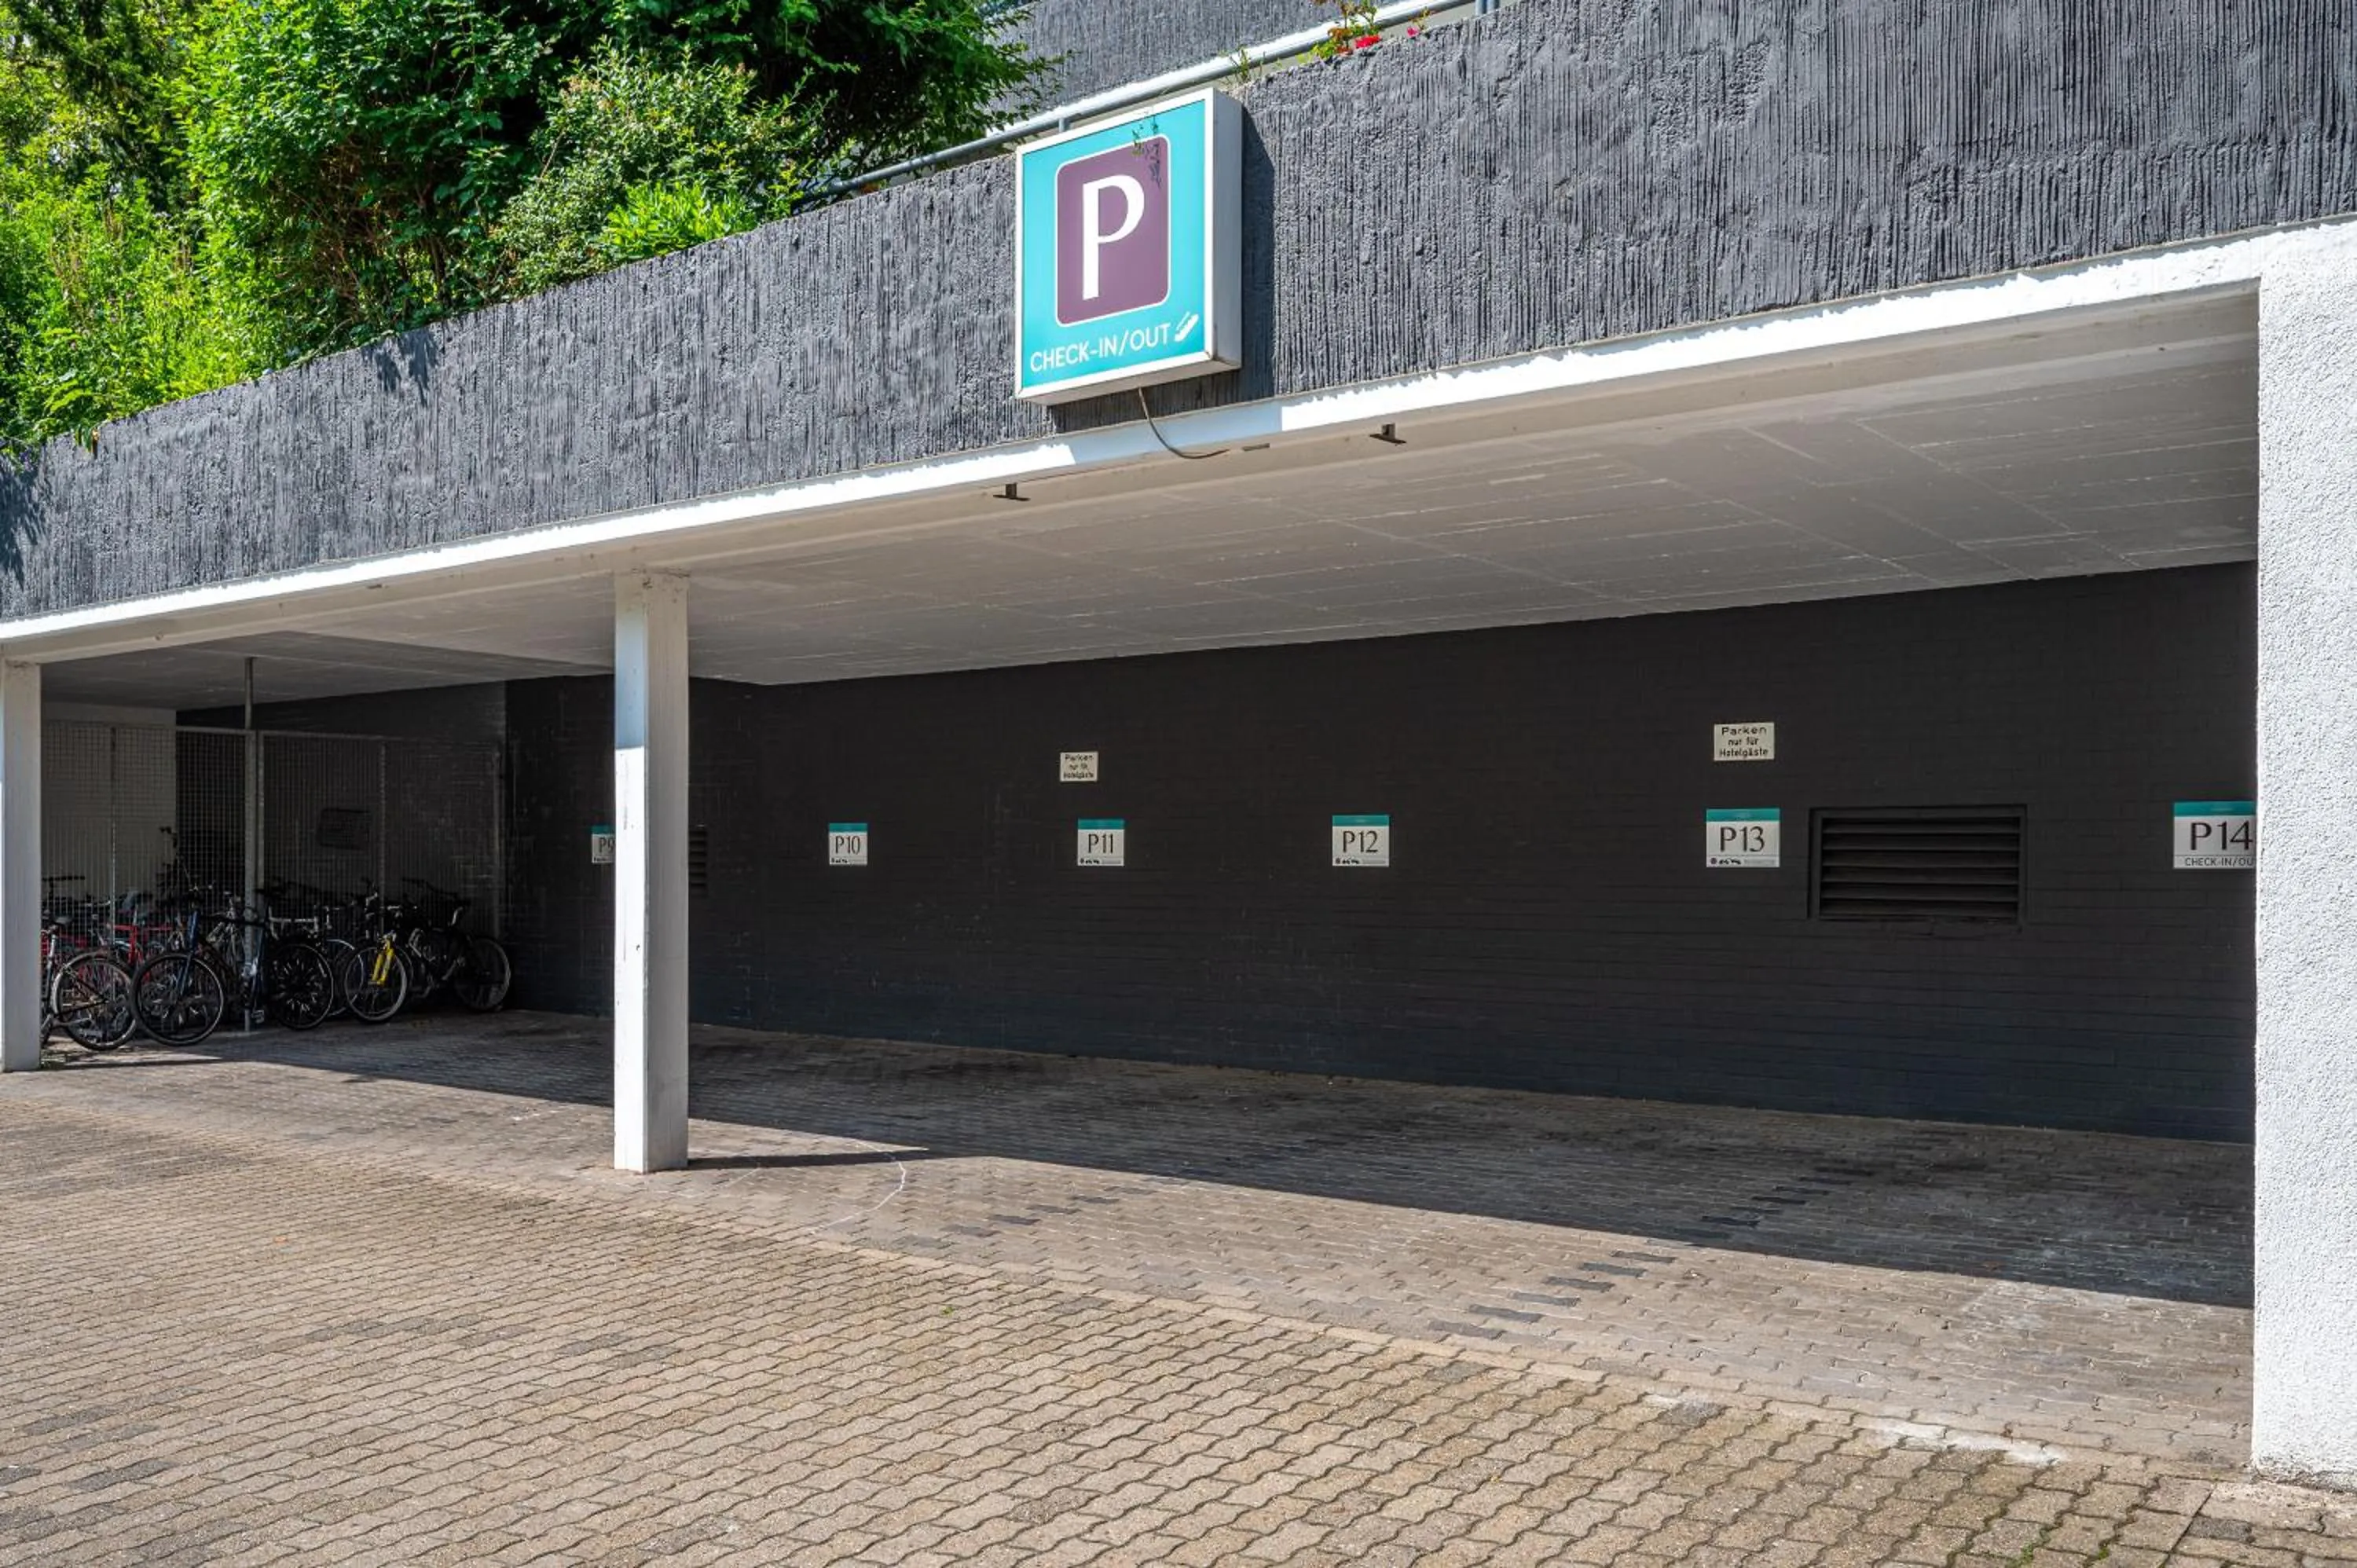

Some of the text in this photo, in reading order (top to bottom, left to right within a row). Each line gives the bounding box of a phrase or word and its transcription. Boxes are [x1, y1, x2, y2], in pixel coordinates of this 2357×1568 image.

[1082, 174, 1145, 301] P
[1030, 322, 1171, 372] CHECK-IN/OUT
[1721, 726, 1768, 735] Parken
[835, 835, 860, 855] P10
[1088, 833, 1114, 854] P11
[1343, 830, 1378, 853] P12
[1720, 826, 1765, 852] P13
[2190, 820, 2254, 851] P14
[2185, 857, 2256, 866] CHECK-IN/OU
